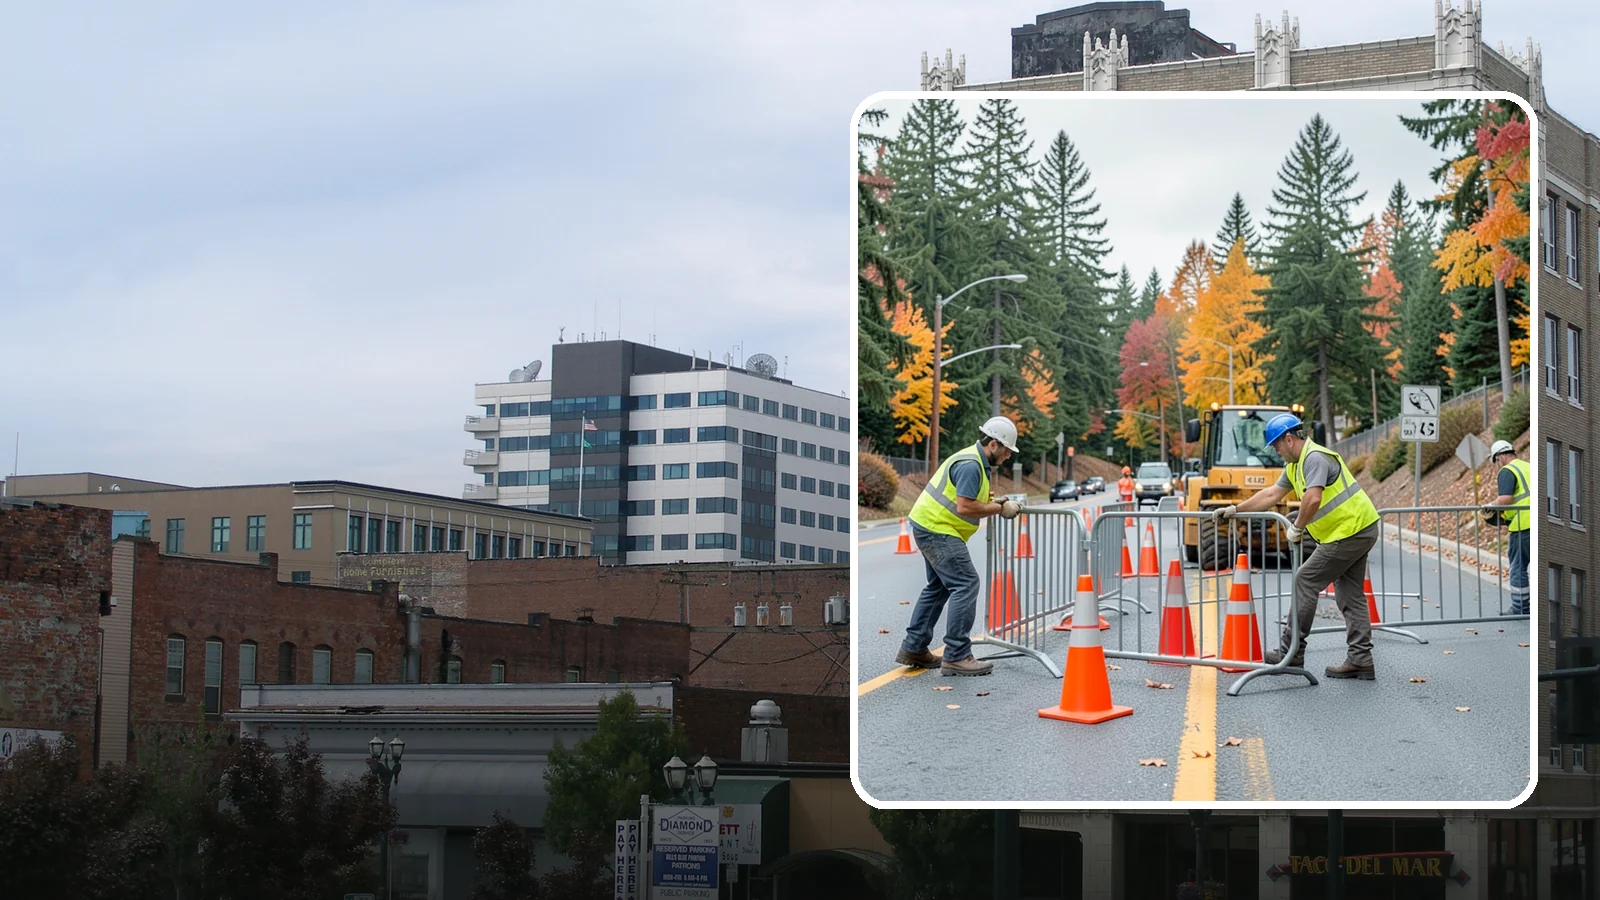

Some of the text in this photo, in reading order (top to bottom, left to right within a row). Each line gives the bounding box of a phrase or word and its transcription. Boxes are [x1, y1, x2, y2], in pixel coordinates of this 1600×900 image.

[370, 566, 427, 577] Furnishers
[660, 818, 713, 833] DIAMOND
[1022, 815, 1070, 828] BUILDING
[656, 845, 716, 854] RESERVED PARKING
[616, 825, 625, 893] PAY HERE
[627, 824, 637, 893] PAY HERE
[721, 851, 739, 862] Soup
[1345, 856, 1385, 875] DEL
[1391, 857, 1442, 876] MAR
[660, 888, 710, 898] PUBLIC PARKING
